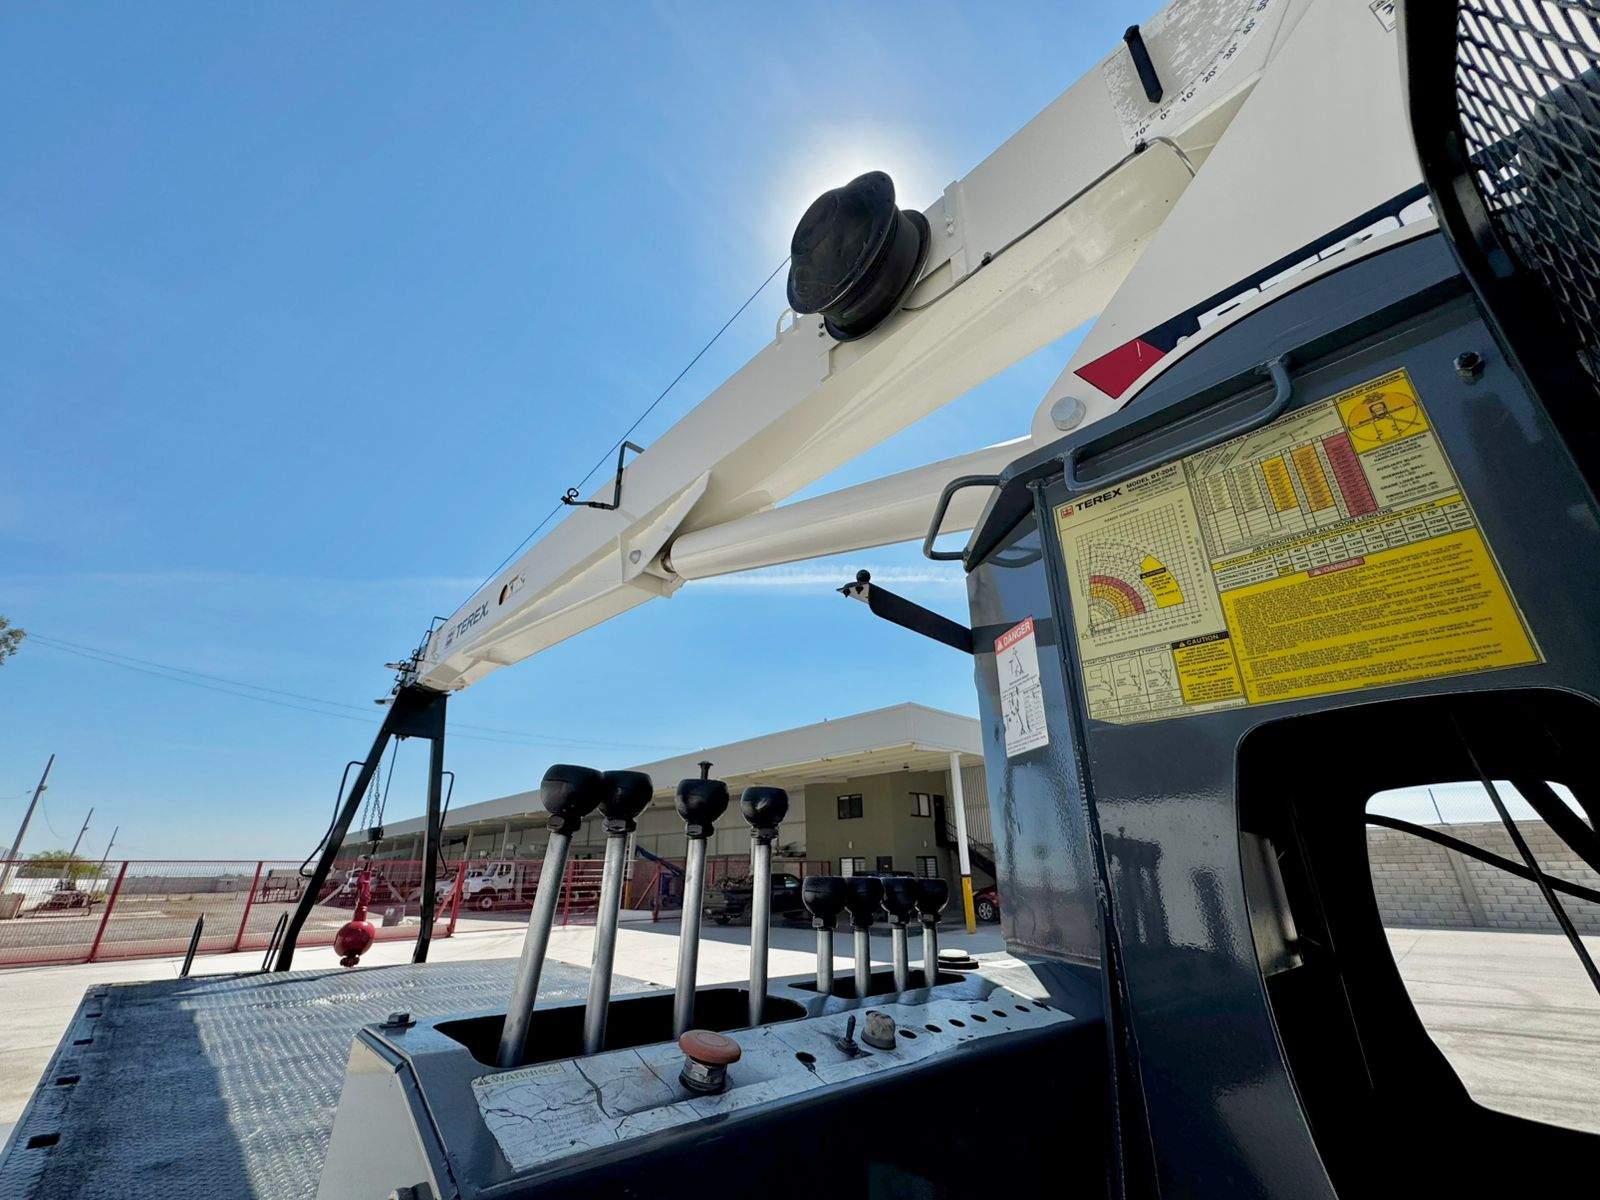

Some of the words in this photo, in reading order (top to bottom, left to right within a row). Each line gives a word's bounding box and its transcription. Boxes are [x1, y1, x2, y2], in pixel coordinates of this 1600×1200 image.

[1126, 476, 1149, 488] MODEL
[1076, 488, 1122, 511] TEREX
[1262, 533, 1302, 549] CAPACITIES
[1302, 529, 1317, 537] FOR
[1318, 525, 1332, 533] ALL
[1332, 518, 1356, 529] BOOM
[1356, 507, 1393, 521] LENGTHS
[1323, 558, 1359, 572] DANGER
[456, 601, 489, 638] TEREX
[1003, 621, 1032, 646] DANGER
[1186, 634, 1219, 645] CAUTION
[490, 1066, 560, 1082] WARNING
